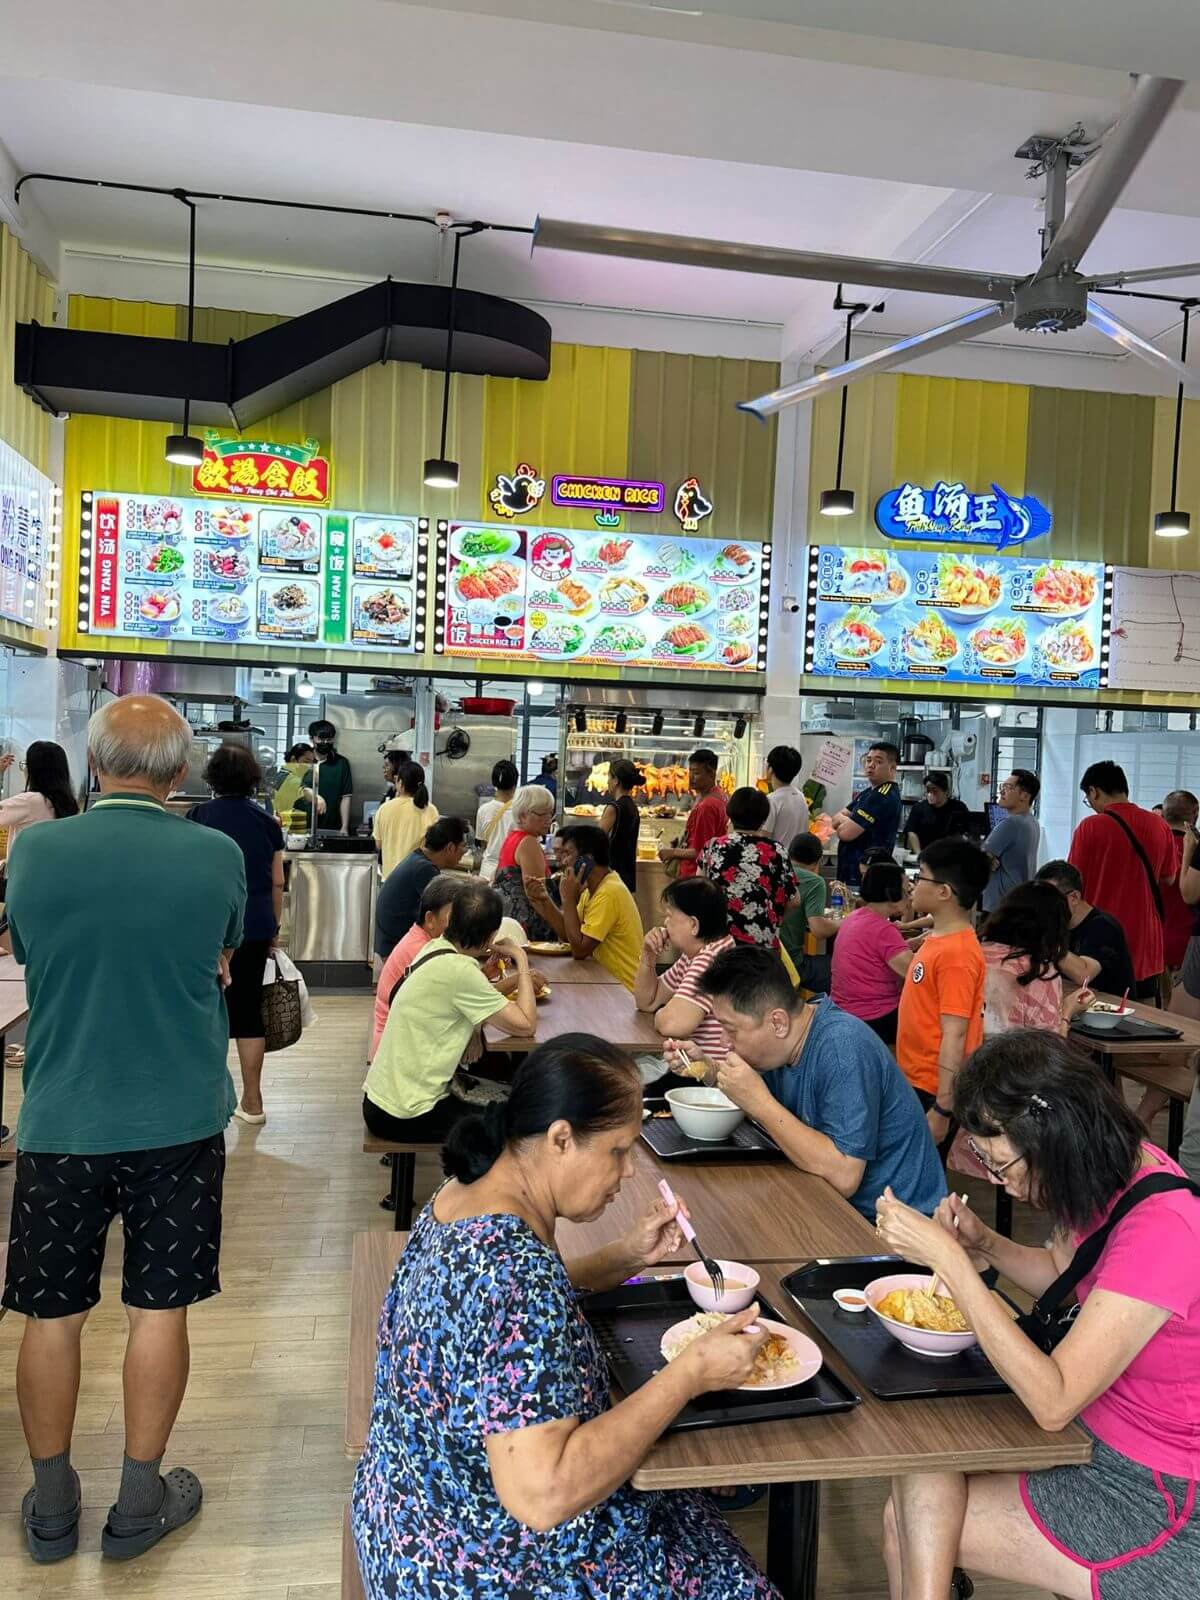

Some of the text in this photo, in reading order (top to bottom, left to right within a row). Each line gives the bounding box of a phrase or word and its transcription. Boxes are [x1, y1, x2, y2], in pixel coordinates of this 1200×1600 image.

[558, 483, 659, 504] CHICKEN RICE
[894, 482, 1003, 530] 鱼汤王
[100, 559, 112, 617] YIN TANG
[331, 575, 342, 622] SHI FAN
[495, 638, 509, 646] RICE
